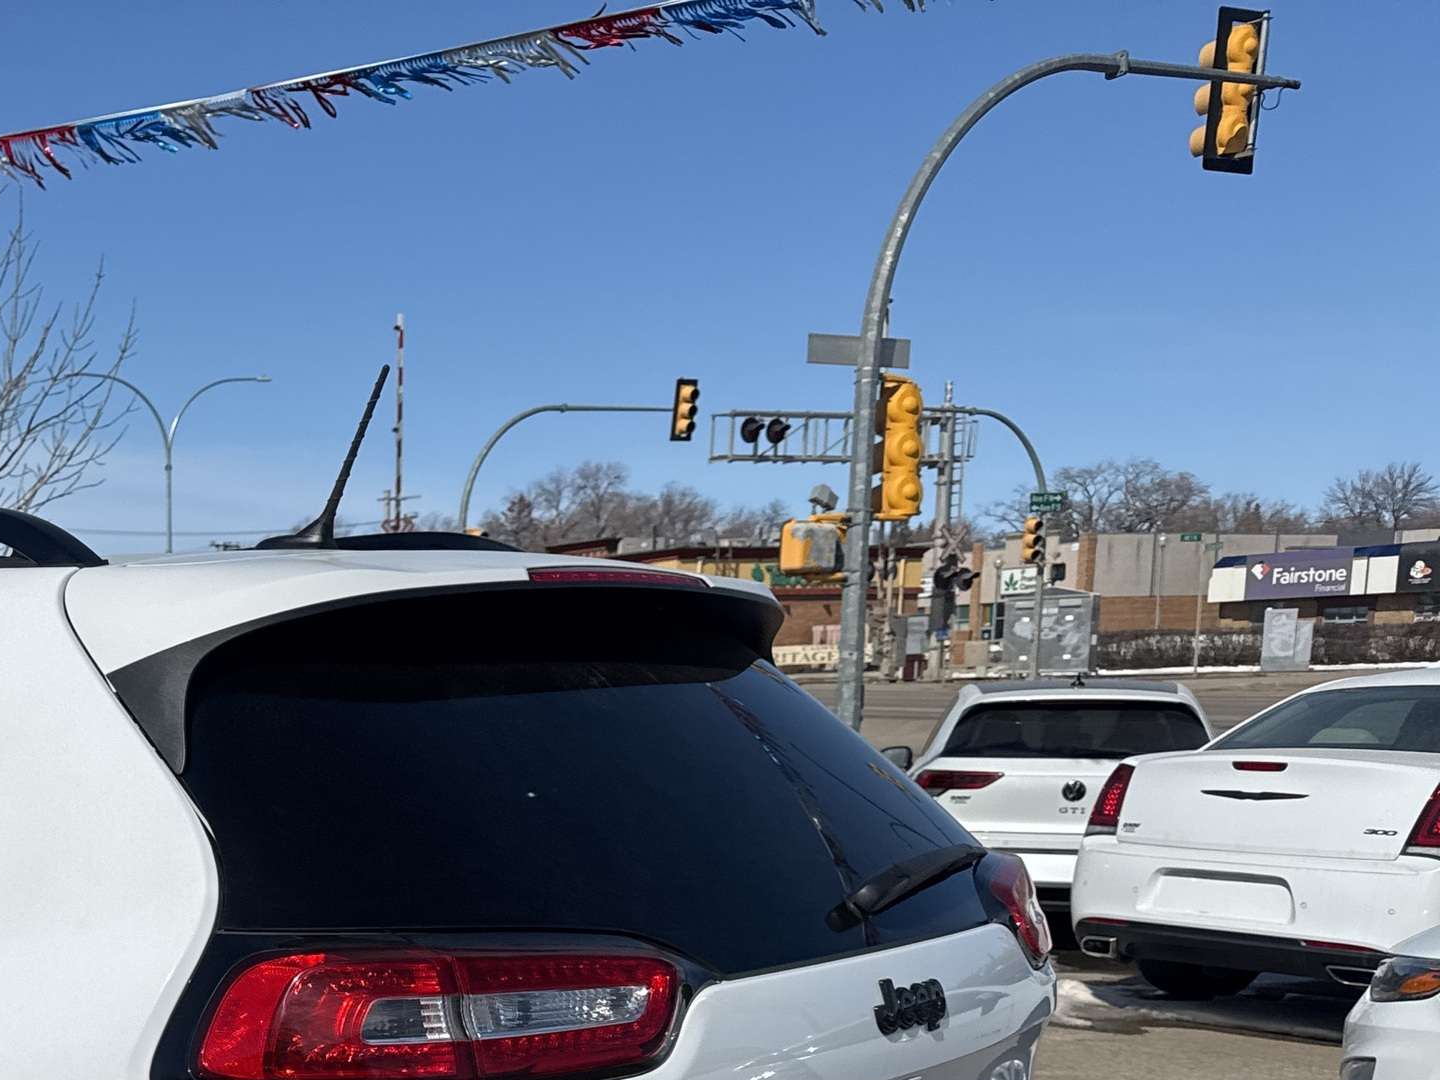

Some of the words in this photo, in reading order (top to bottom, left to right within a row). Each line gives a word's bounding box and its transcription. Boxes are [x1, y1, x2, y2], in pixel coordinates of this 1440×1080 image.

[1272, 566, 1347, 585] Fairstone
[1314, 583, 1346, 593] Financial
[1058, 806, 1086, 815] GTI
[1363, 828, 1398, 836] 300
[873, 978, 947, 1036] Jeep
